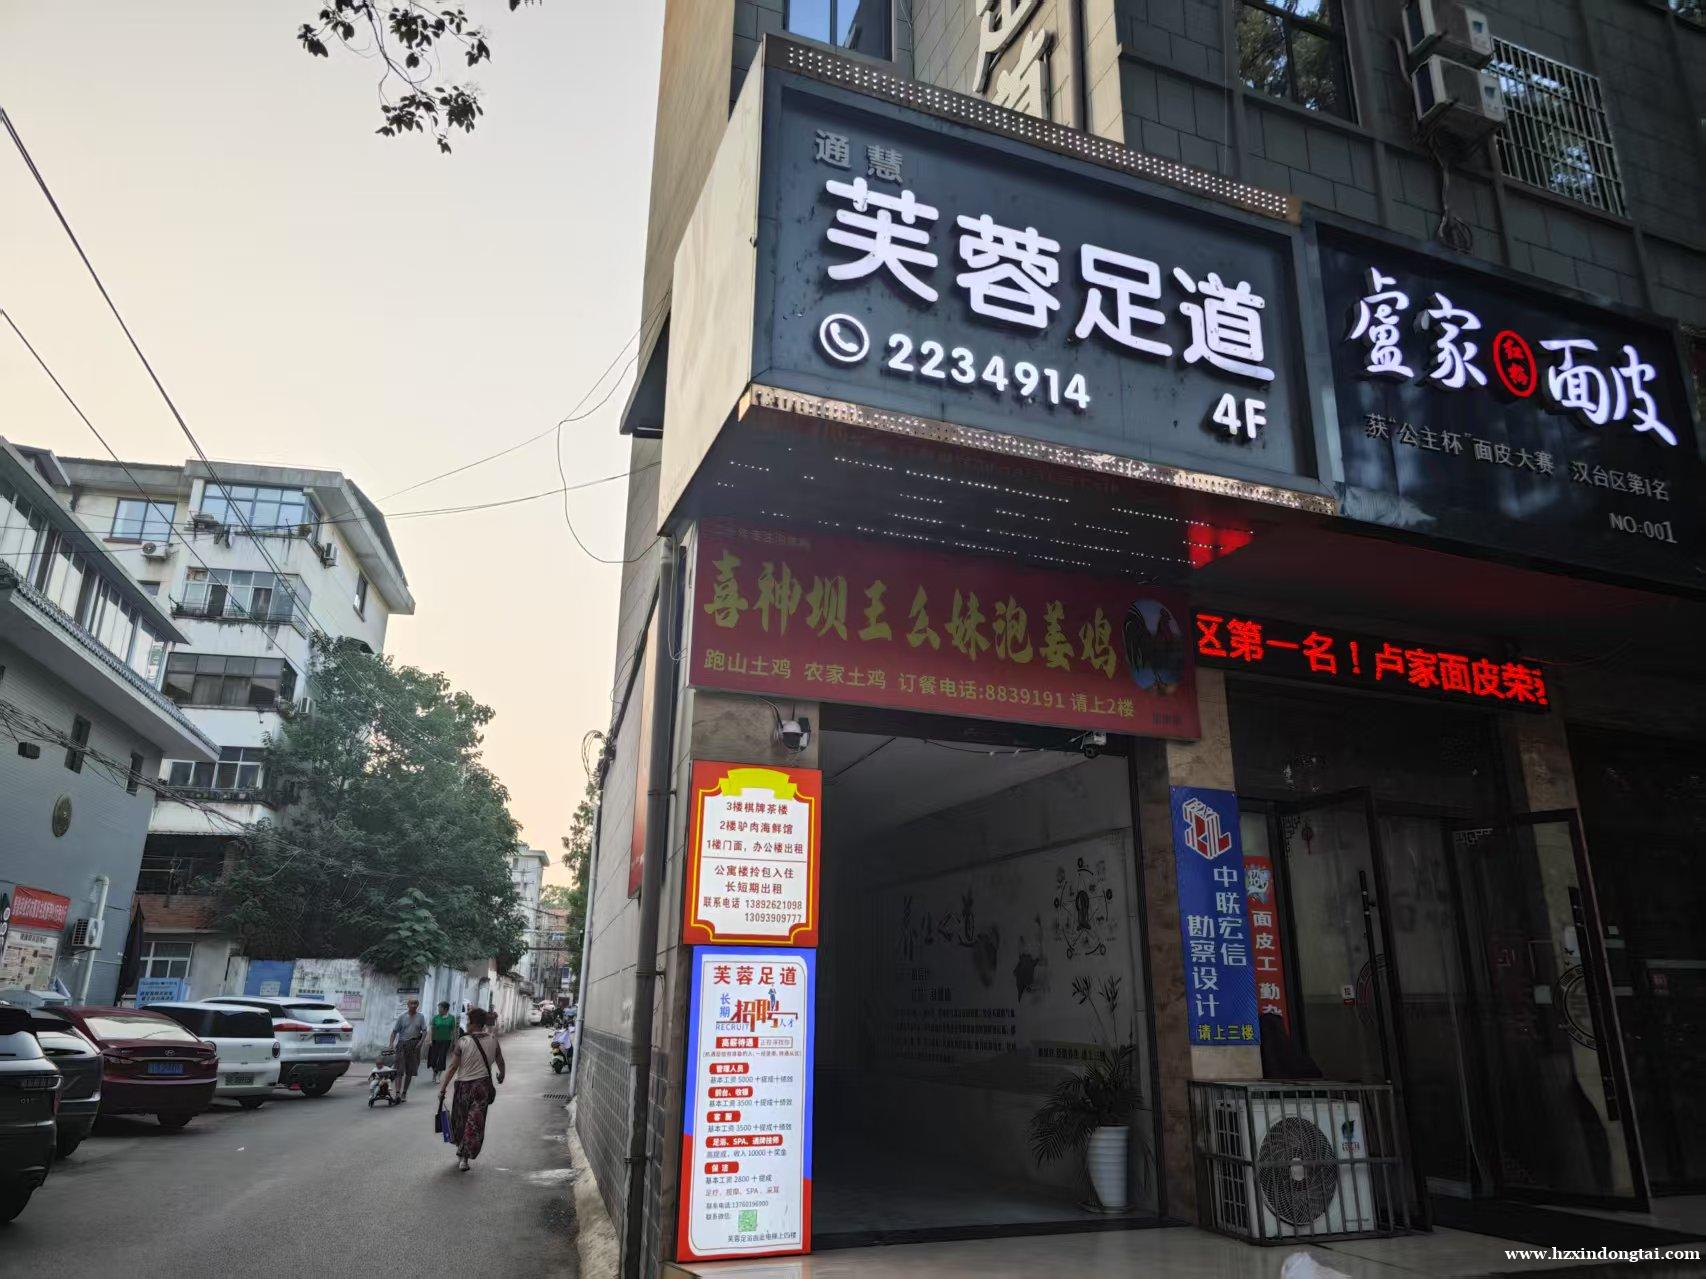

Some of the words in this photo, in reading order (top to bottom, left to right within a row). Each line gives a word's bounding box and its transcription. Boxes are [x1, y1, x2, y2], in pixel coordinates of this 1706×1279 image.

[814, 129, 904, 183] 通慧
[826, 177, 1275, 381] 芙蓉足道
[888, 333, 1090, 409] 2234914
[1538, 338, 1678, 446] 面皮
[1212, 393, 1267, 440] 4F
[704, 649, 792, 680] 跑山土鸡
[804, 662, 887, 691] 农家土鸡
[899, 673, 1065, 710] 订餐电话:8839191
[1071, 691, 1136, 719] 请上2楼
[726, 801, 789, 816] 3楼棋牌茶楼
[719, 820, 794, 836] 2楼驴肉海鲜馆
[706, 838, 805, 855] 1楼门面，办公楼出租
[714, 864, 795, 879] 公寓楼拎包入住
[725, 881, 783, 895] 长短期出租
[703, 896, 741, 909] 联系电话
[1213, 865, 1247, 966] 中联宏信
[713, 965, 797, 986] 芙蓉足道
[1186, 914, 1219, 1018] 勘察设计
[720, 992, 731, 1018] 长期
[730, 998, 798, 1033] 招聘
[715, 1023, 750, 1031] RECRUIT
[780, 1018, 794, 1028] 人才
[1196, 1024, 1255, 1042] 请上三楼
